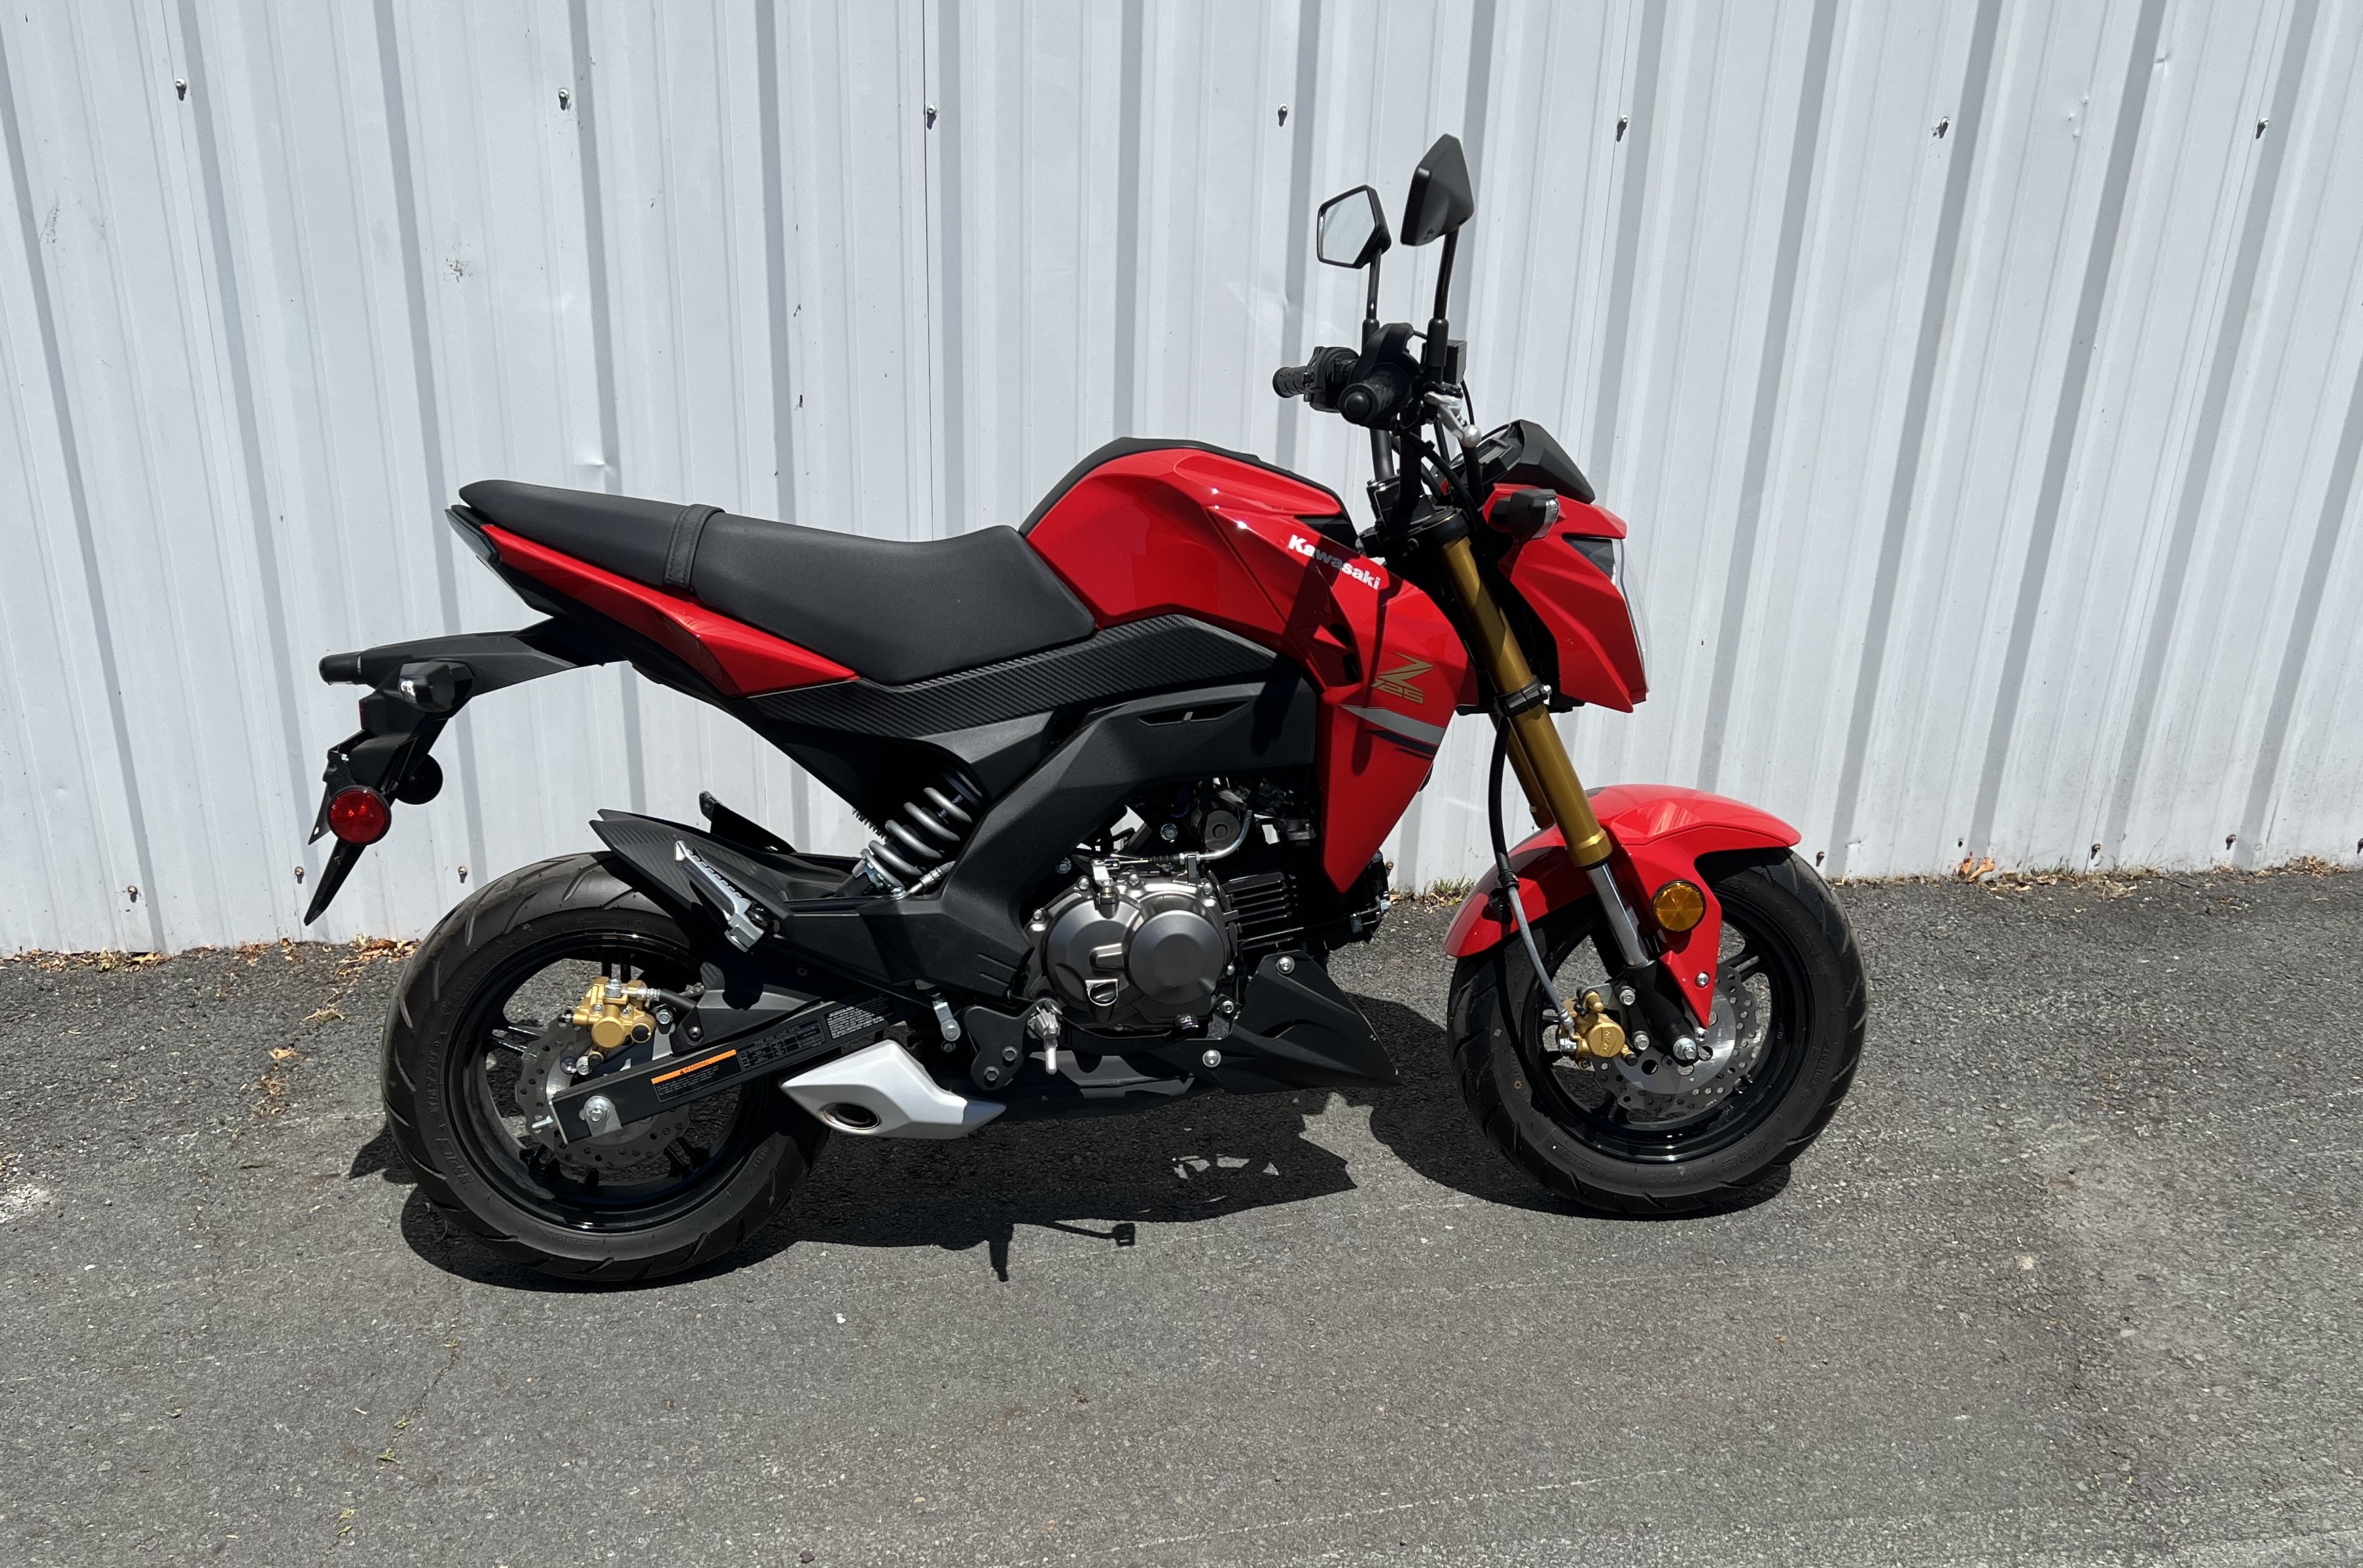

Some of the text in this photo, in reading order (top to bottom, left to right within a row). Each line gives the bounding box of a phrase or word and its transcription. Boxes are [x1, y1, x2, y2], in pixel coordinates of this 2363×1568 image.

[1288, 535, 1381, 590] Kawasaki
[1376, 651, 1434, 694] Z
[1370, 679, 1424, 704] 125
[684, 1060, 709, 1073] WARNING
